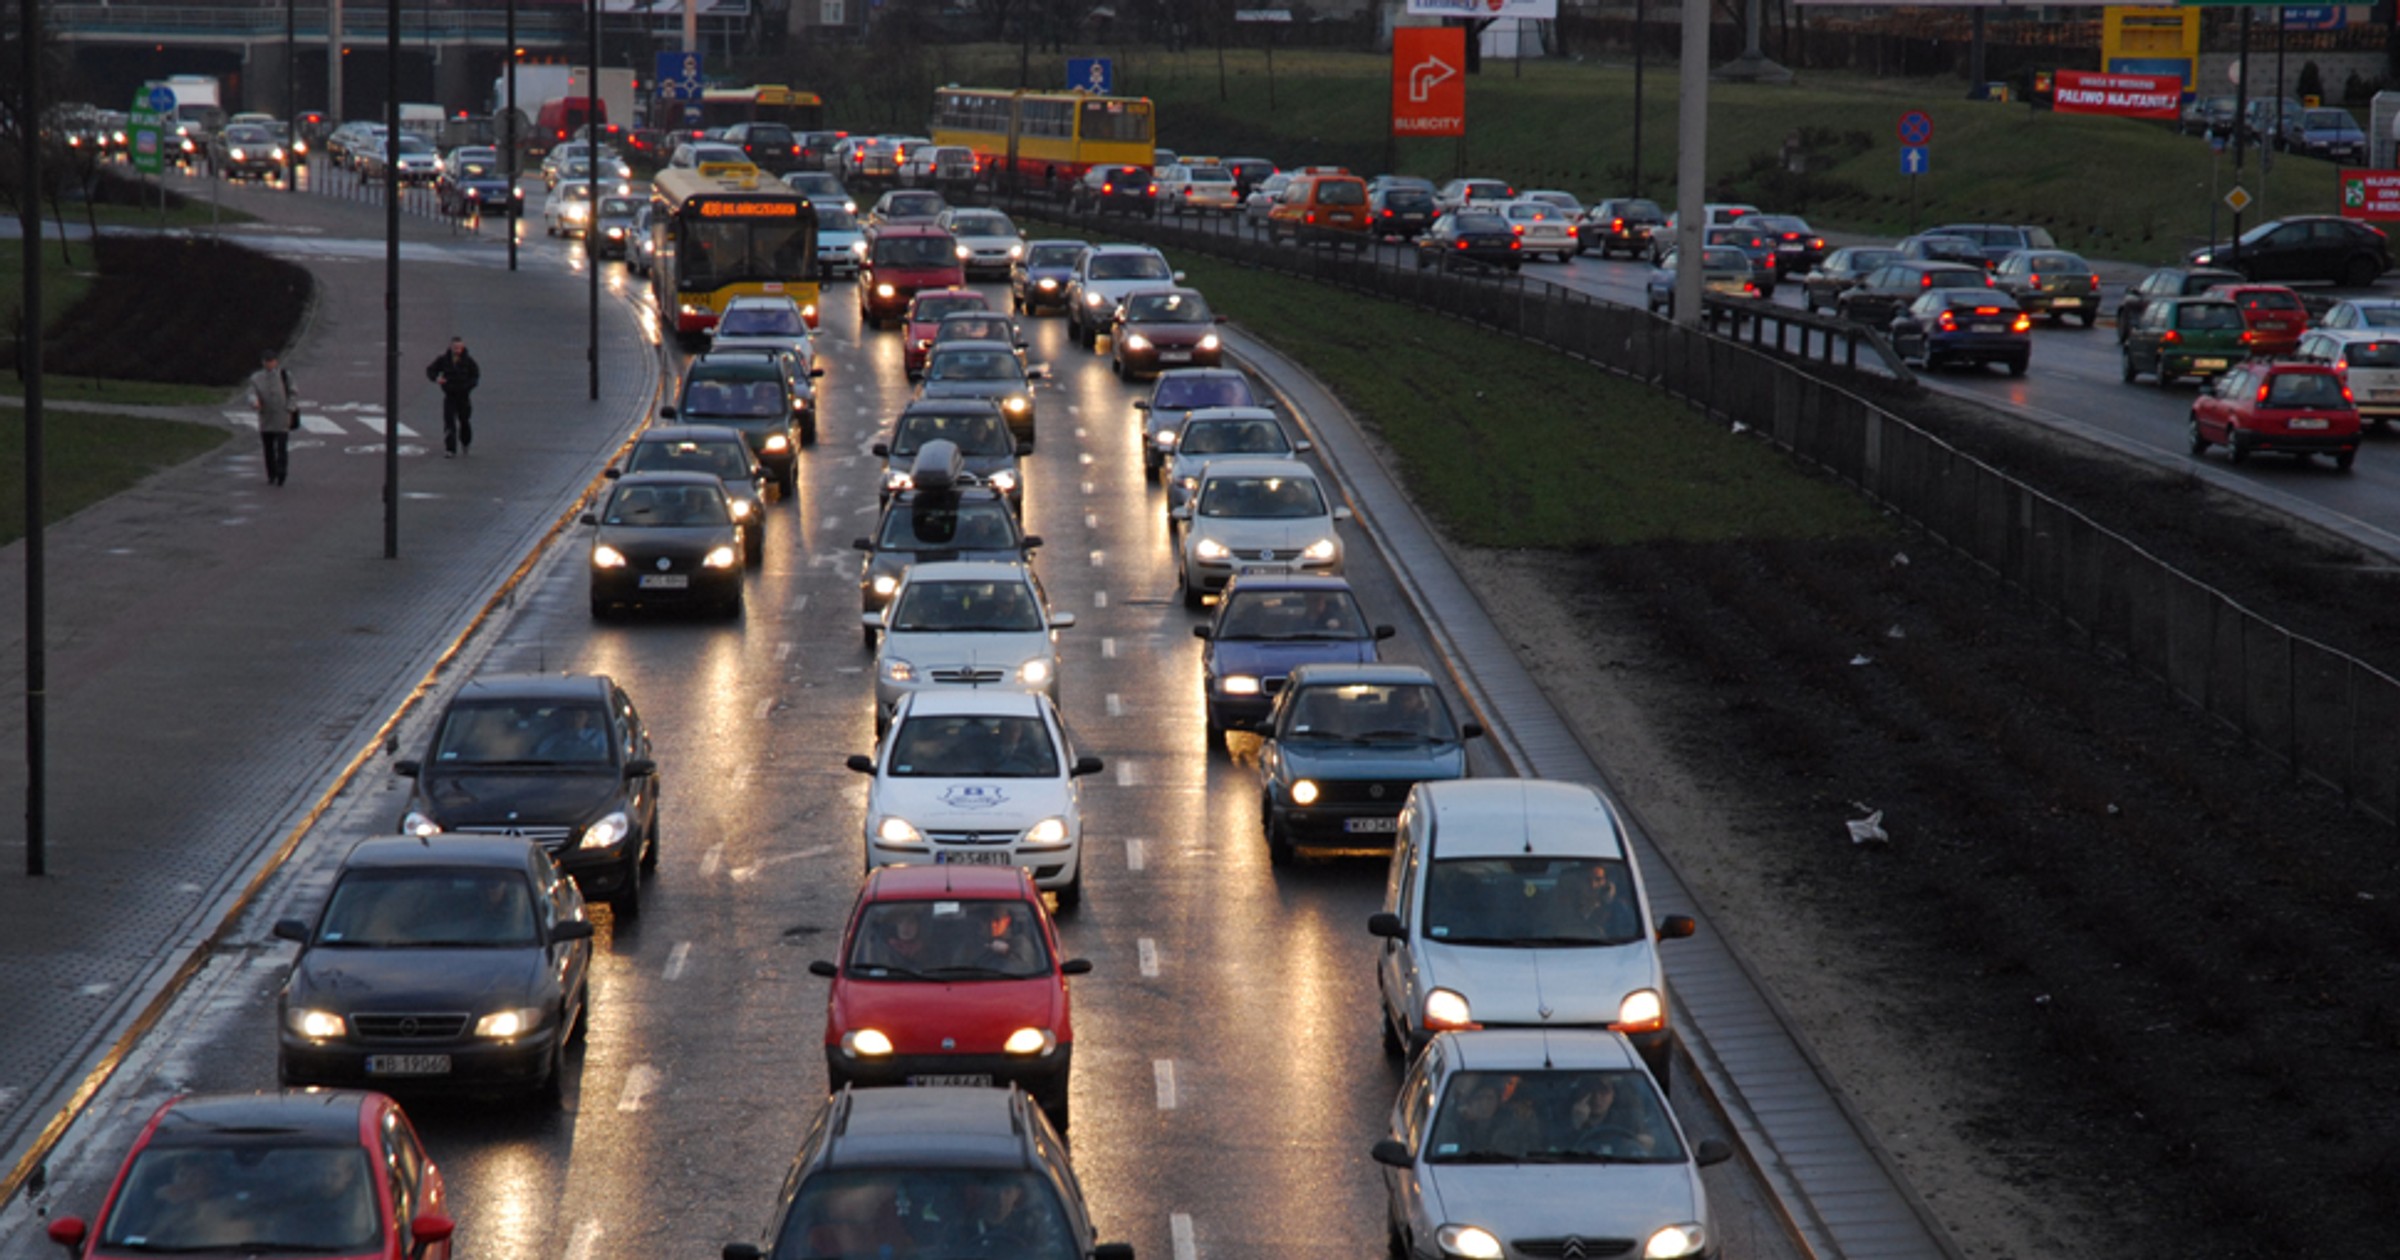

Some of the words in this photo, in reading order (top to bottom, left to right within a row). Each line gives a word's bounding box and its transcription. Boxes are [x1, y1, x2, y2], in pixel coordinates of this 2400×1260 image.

[2058, 89, 2104, 105] PALIWO
[2107, 92, 2177, 109] NAJTANIEJ
[1394, 117, 1461, 129] BLUECITY
